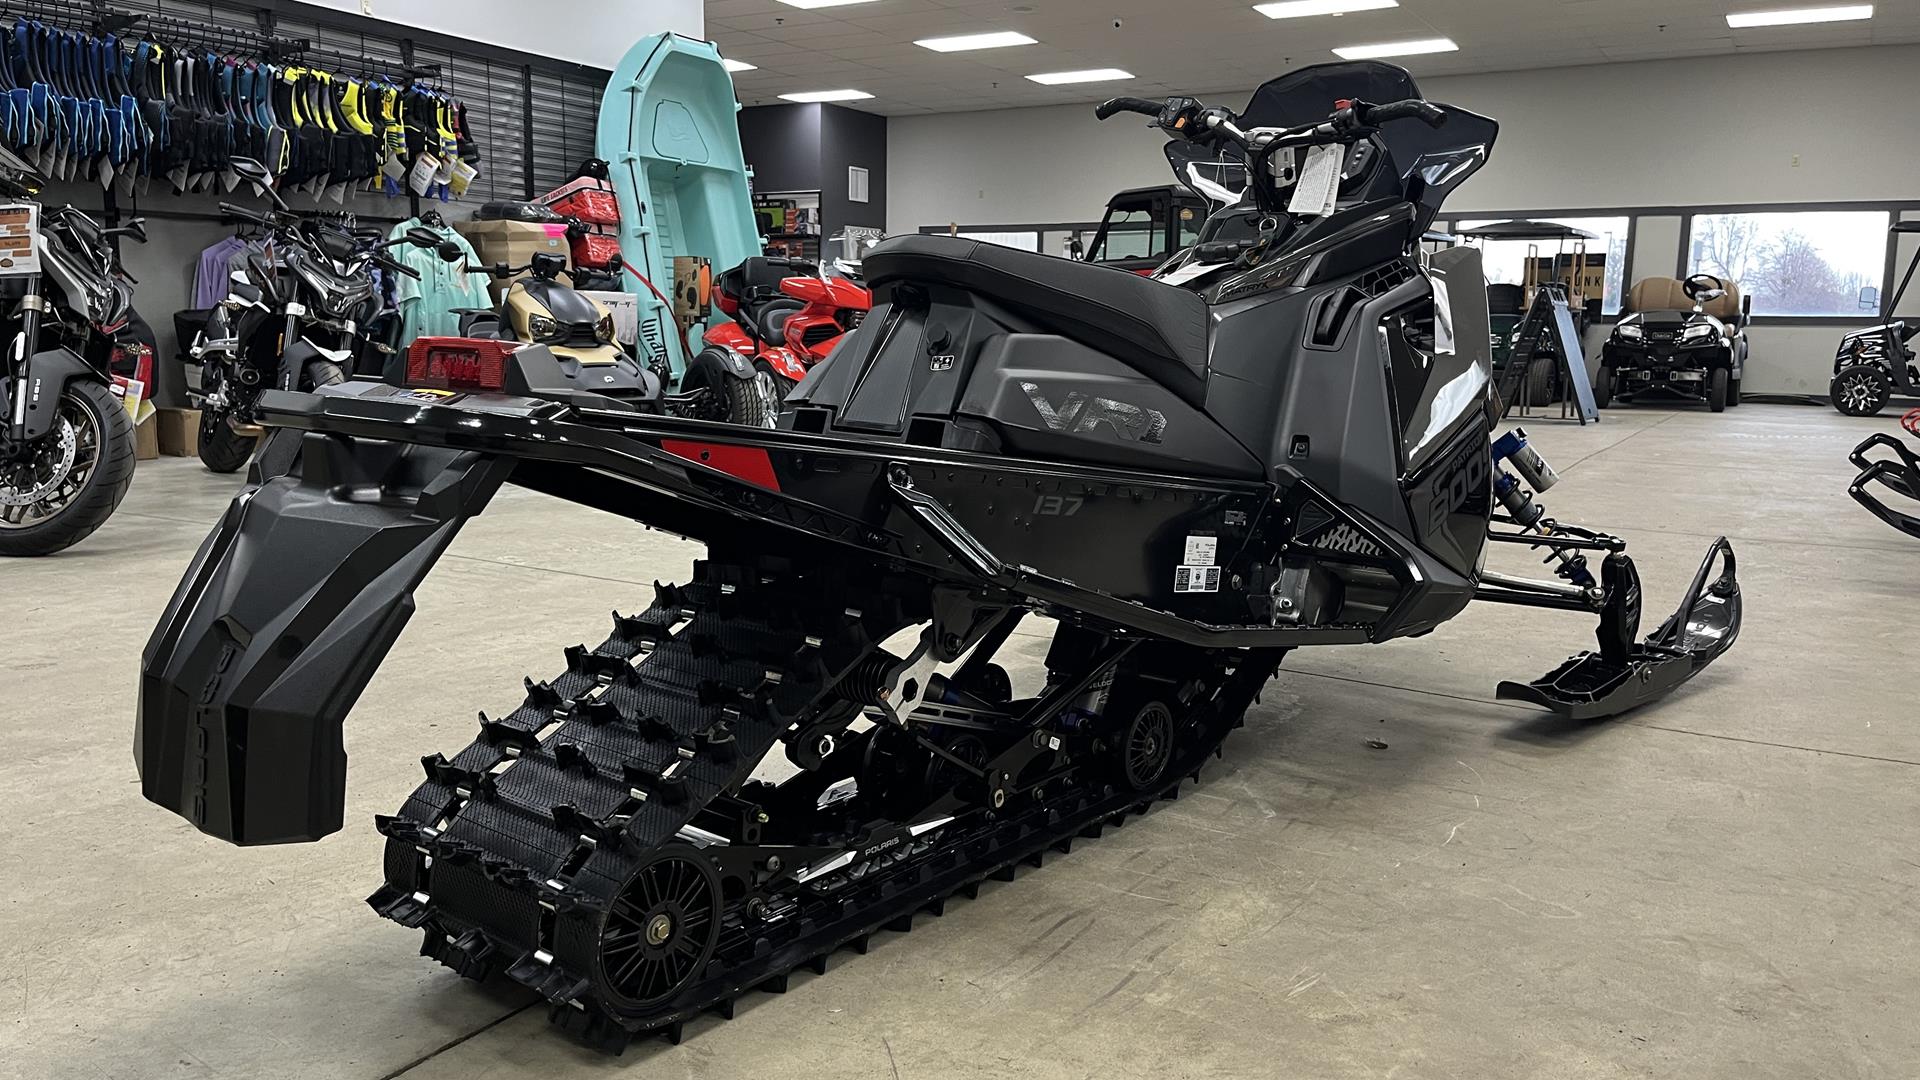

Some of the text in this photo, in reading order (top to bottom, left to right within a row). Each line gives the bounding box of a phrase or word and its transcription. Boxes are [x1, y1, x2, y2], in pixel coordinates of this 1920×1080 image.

[1221, 282, 1269, 299] MATRYX
[1032, 495, 1085, 517] 137
[864, 836, 900, 857] POLARIS
